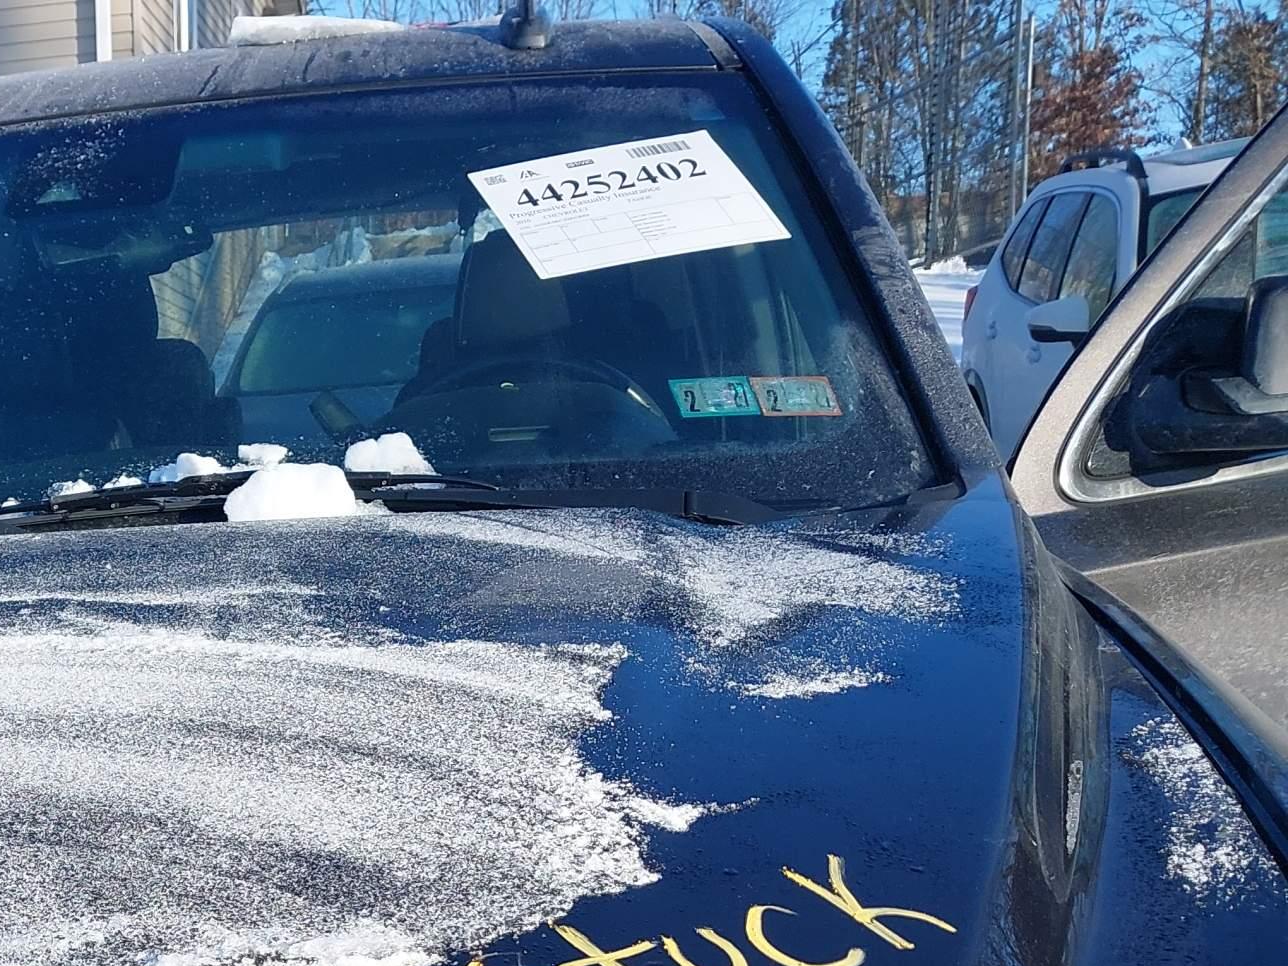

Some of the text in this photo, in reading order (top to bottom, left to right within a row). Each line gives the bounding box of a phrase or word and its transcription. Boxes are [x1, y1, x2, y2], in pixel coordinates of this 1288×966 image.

[516, 158, 707, 207] 44252402
[508, 203, 567, 220] Progressive
[568, 193, 612, 209] Casualty
[613, 186, 663, 201] Insurance
[683, 390, 701, 412] 2
[766, 389, 783, 412] 2
